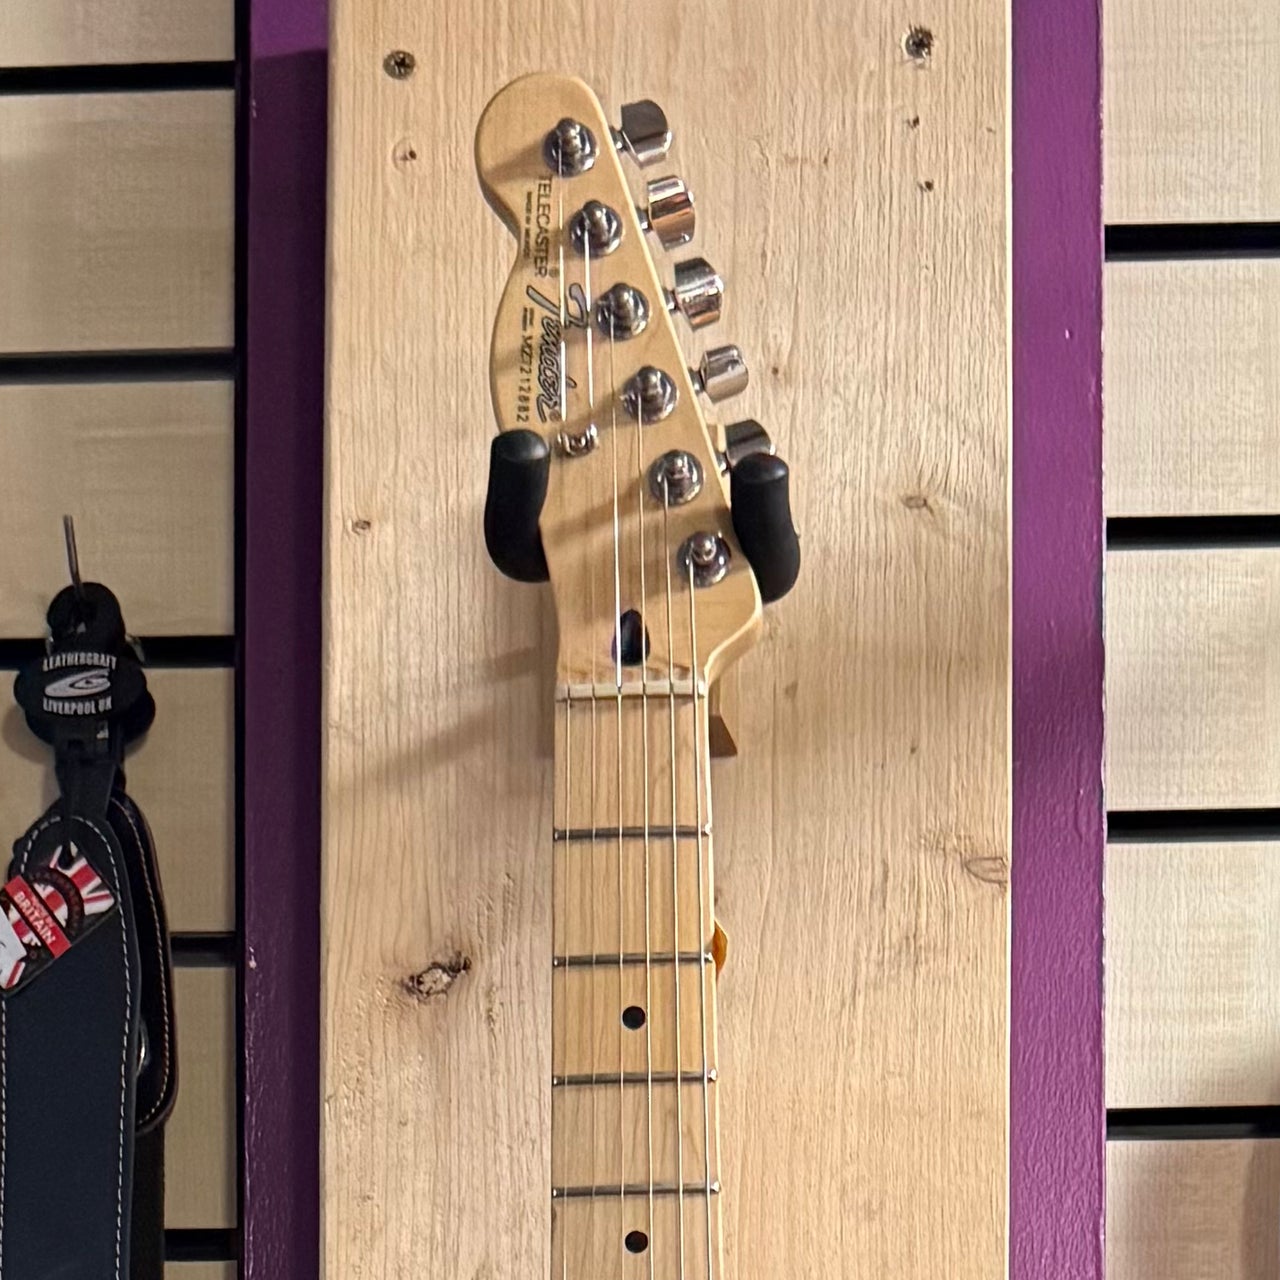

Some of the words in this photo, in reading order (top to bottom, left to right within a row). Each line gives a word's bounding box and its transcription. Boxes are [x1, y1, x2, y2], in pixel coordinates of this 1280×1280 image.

[535, 175, 553, 277] TELECASTER
[526, 282, 588, 423] Fender
[43, 697, 96, 715] LIVERPOOL
[14, 891, 56, 943] BRITAIN
